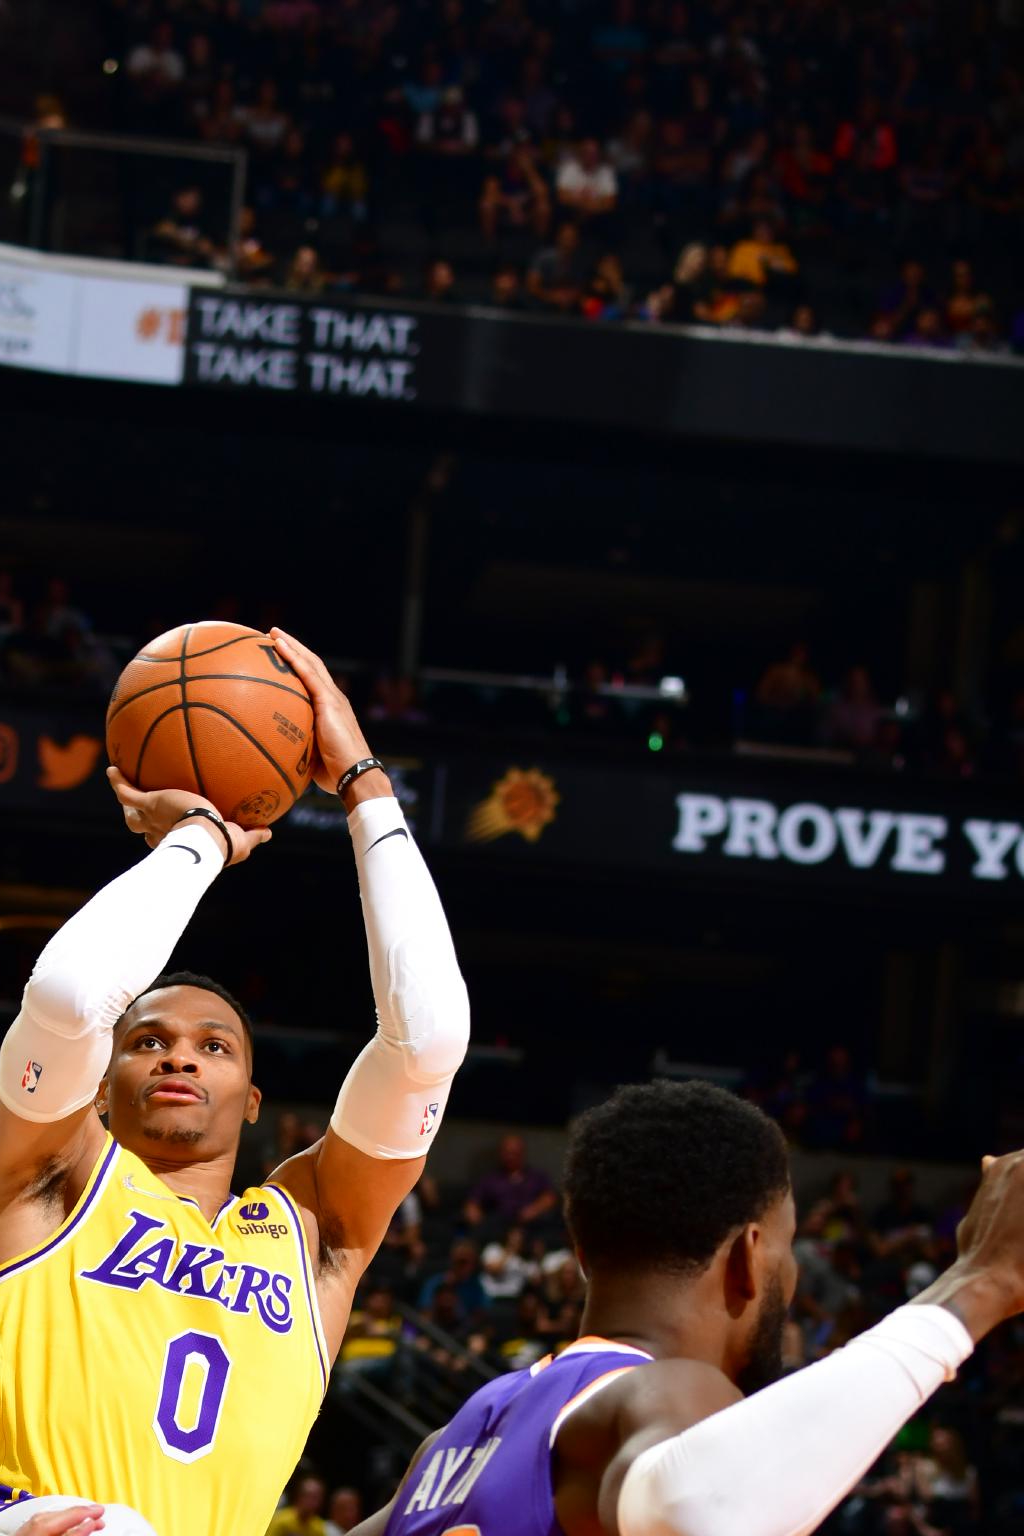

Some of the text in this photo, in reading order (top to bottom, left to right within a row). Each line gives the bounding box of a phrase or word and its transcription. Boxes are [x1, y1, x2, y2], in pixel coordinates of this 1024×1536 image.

[195, 297, 418, 356] TAKE THAT.
[191, 341, 414, 401] TAKE THAT.
[673, 792, 1024, 879] PROVE Y
[236, 1222, 288, 1239] bibigo
[80, 1210, 294, 1335] LAKERS
[152, 1328, 232, 1465] 0
